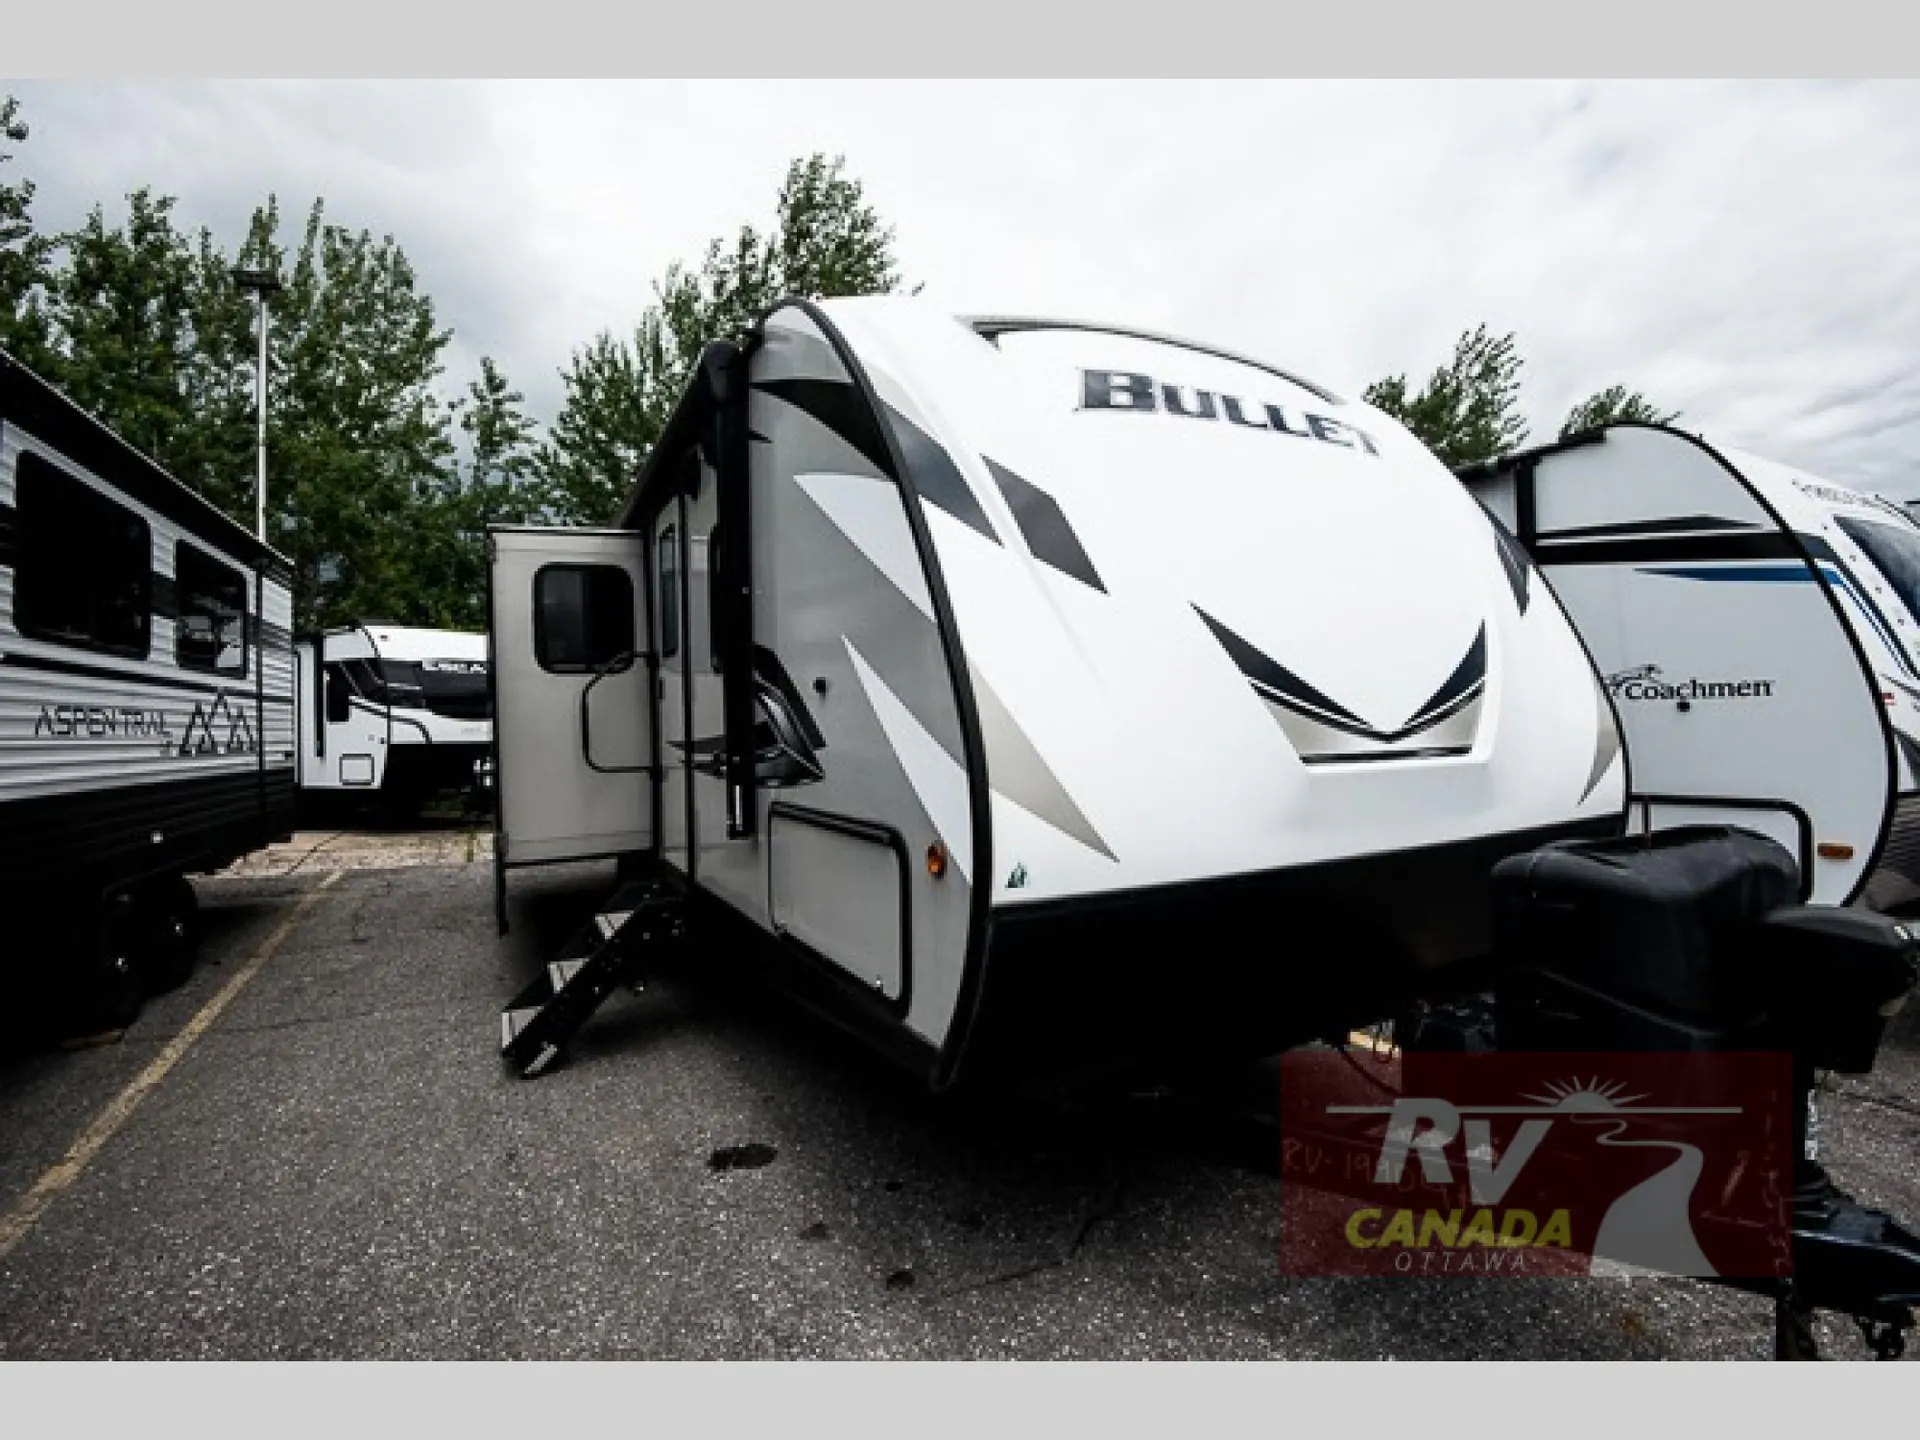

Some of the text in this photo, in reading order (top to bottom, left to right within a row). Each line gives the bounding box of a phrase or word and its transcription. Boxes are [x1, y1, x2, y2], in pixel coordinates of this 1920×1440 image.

[1624, 677, 1773, 700] Coachmen
[34, 704, 172, 737] ASPEN TRAIL
